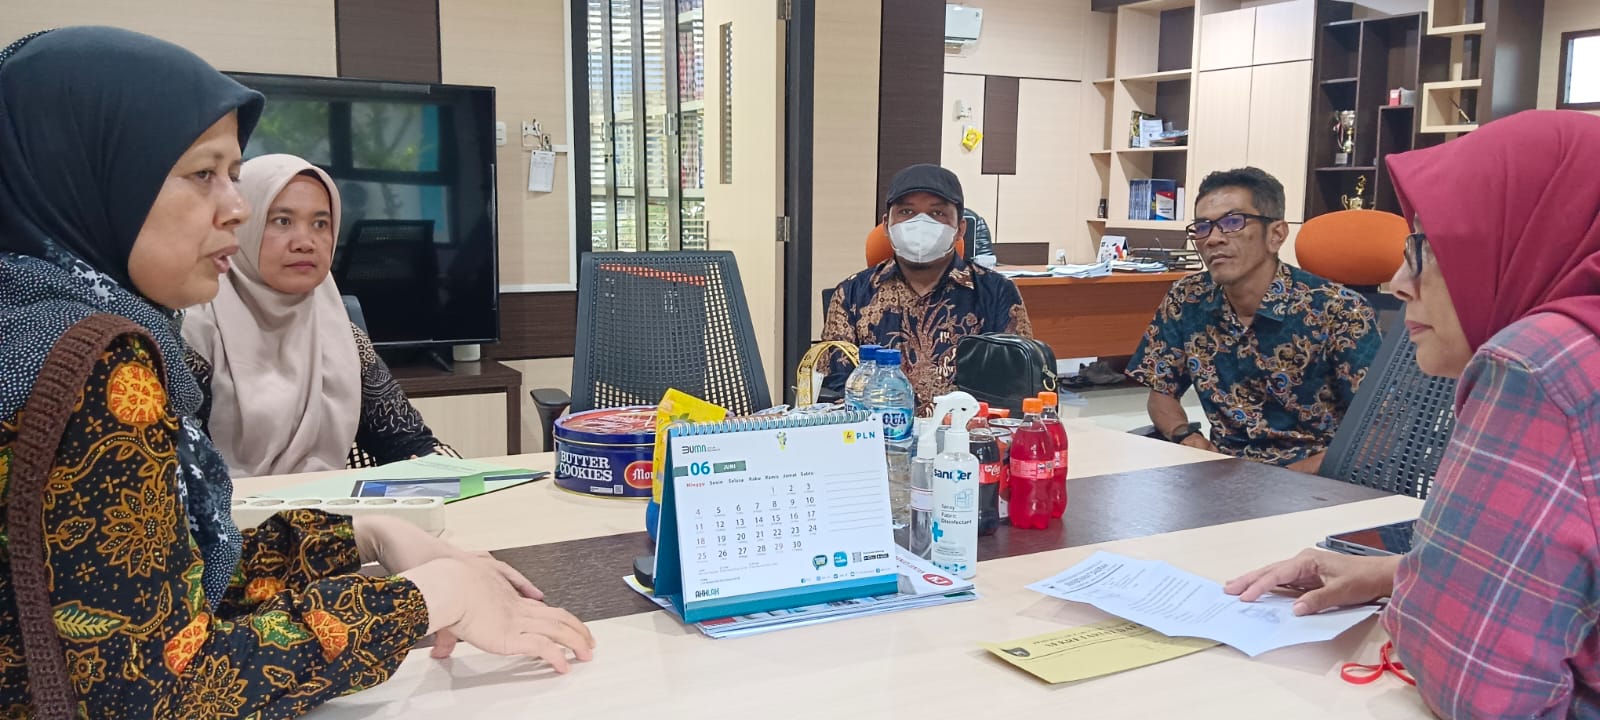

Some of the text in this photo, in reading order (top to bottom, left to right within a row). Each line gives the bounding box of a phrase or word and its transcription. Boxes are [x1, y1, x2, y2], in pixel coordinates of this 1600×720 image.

[882, 413, 906, 426] QUA
[560, 450, 610, 468] BUTTER
[560, 462, 613, 482] COOKIES
[690, 461, 711, 476] 06
